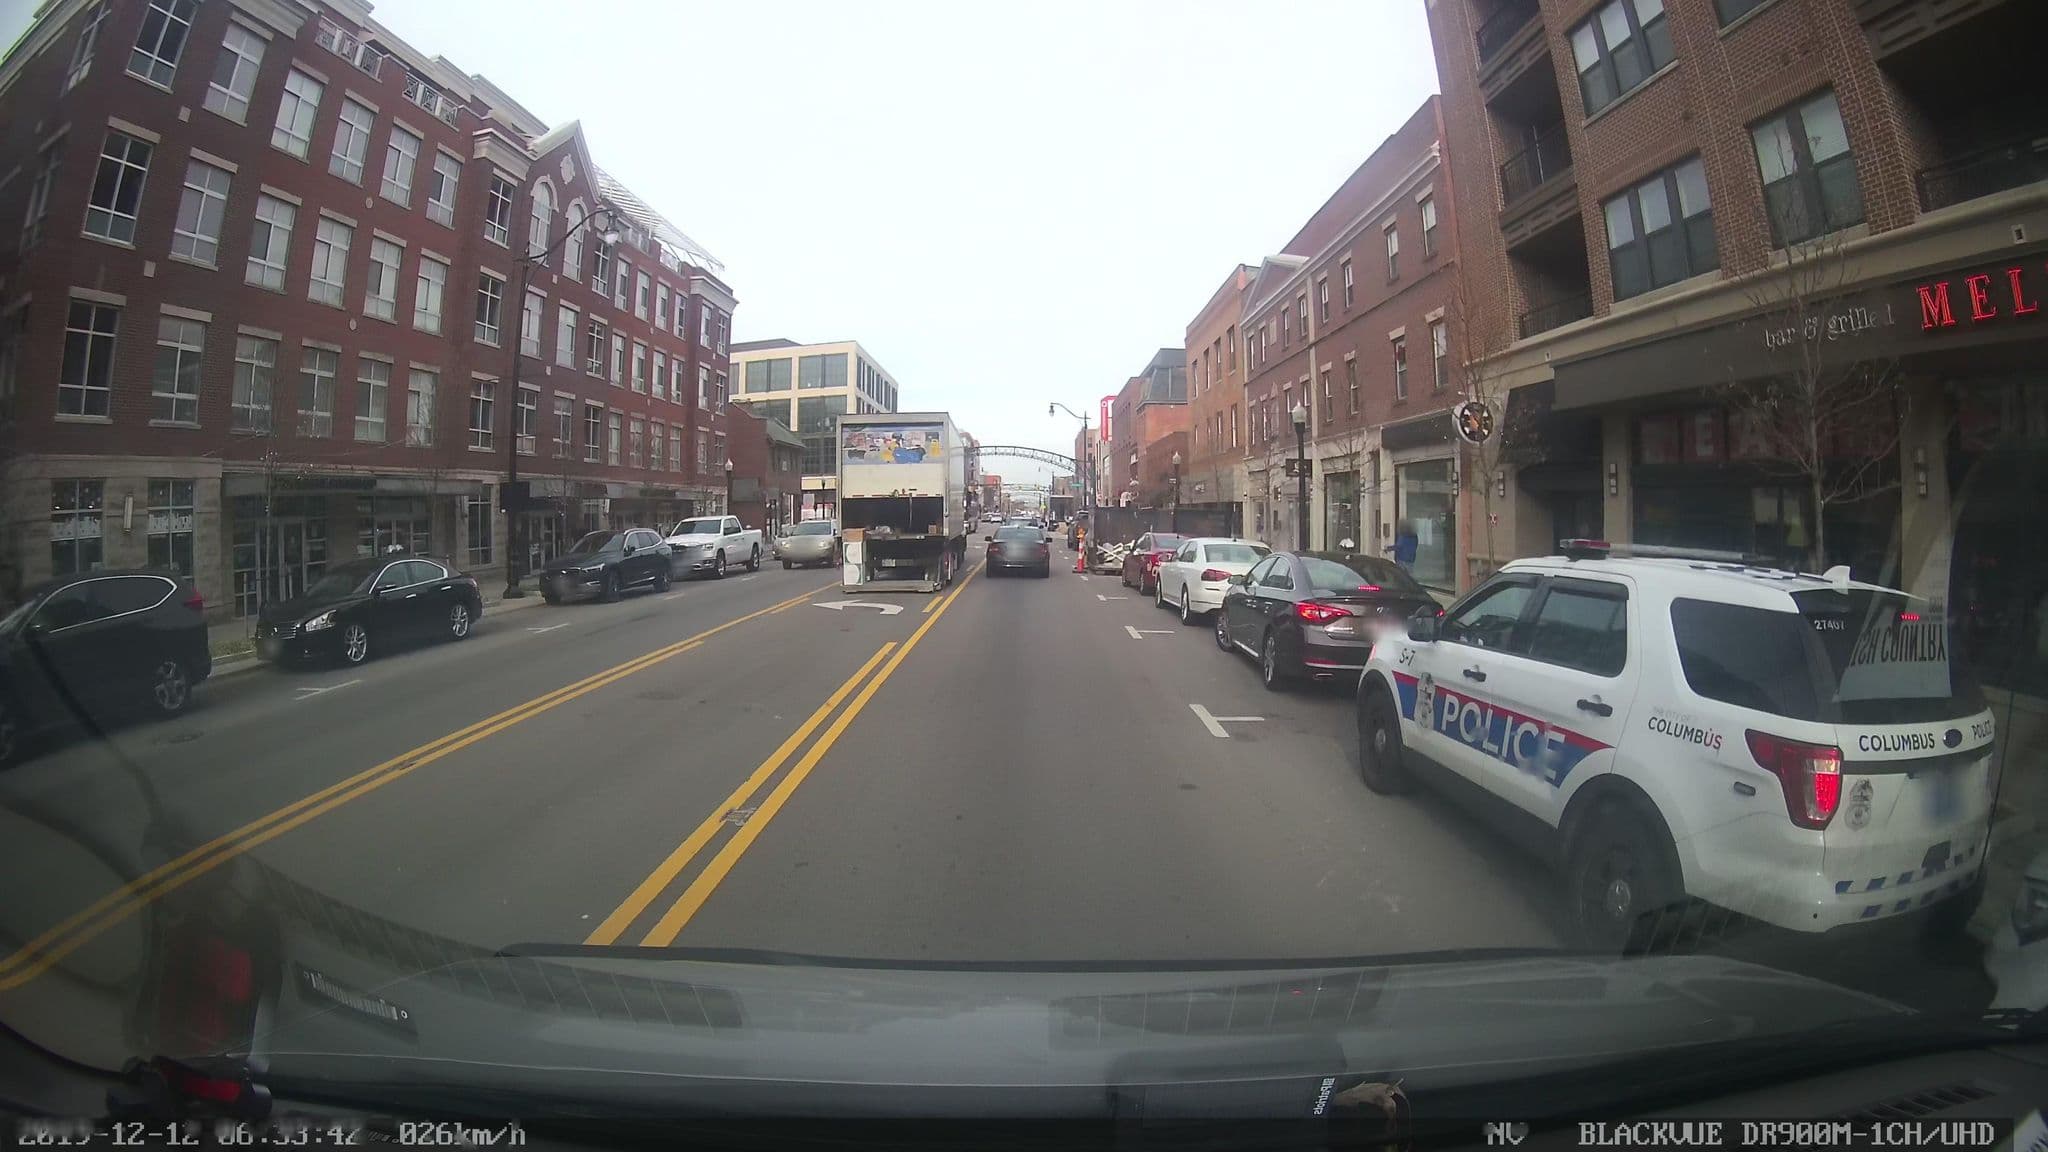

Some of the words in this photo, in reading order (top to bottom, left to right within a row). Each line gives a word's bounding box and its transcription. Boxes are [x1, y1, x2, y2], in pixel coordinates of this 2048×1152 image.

[1916, 262, 2048, 331] MEL
[1399, 648, 1416, 666] S-7
[1440, 693, 1567, 782] POLICE
[1648, 716, 1722, 750] COLUMBUS
[1859, 733, 1935, 752] COLUMBUS
